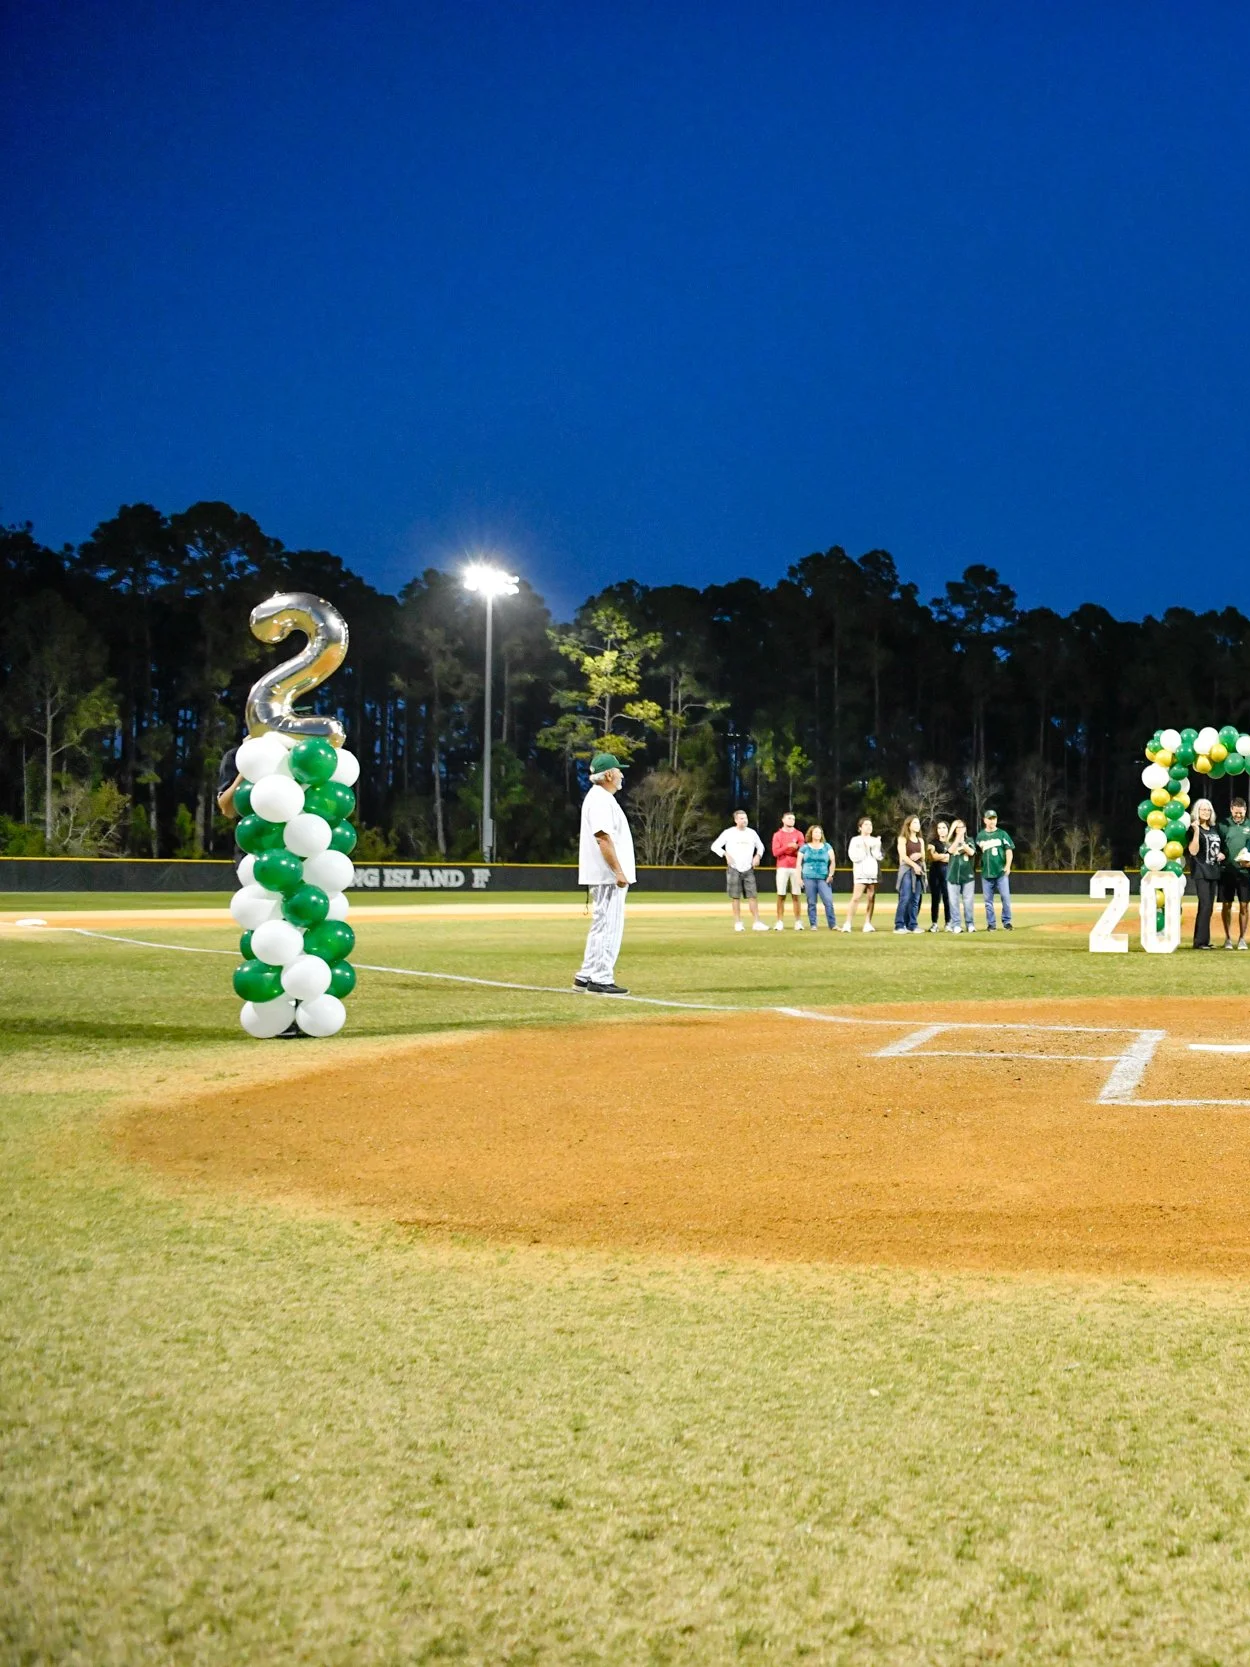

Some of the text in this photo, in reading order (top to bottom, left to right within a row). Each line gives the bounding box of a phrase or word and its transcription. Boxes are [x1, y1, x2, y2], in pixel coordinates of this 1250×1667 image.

[245, 591, 349, 749] 2
[383, 868, 465, 888] ISLAND
[1089, 870, 1182, 954] 20
